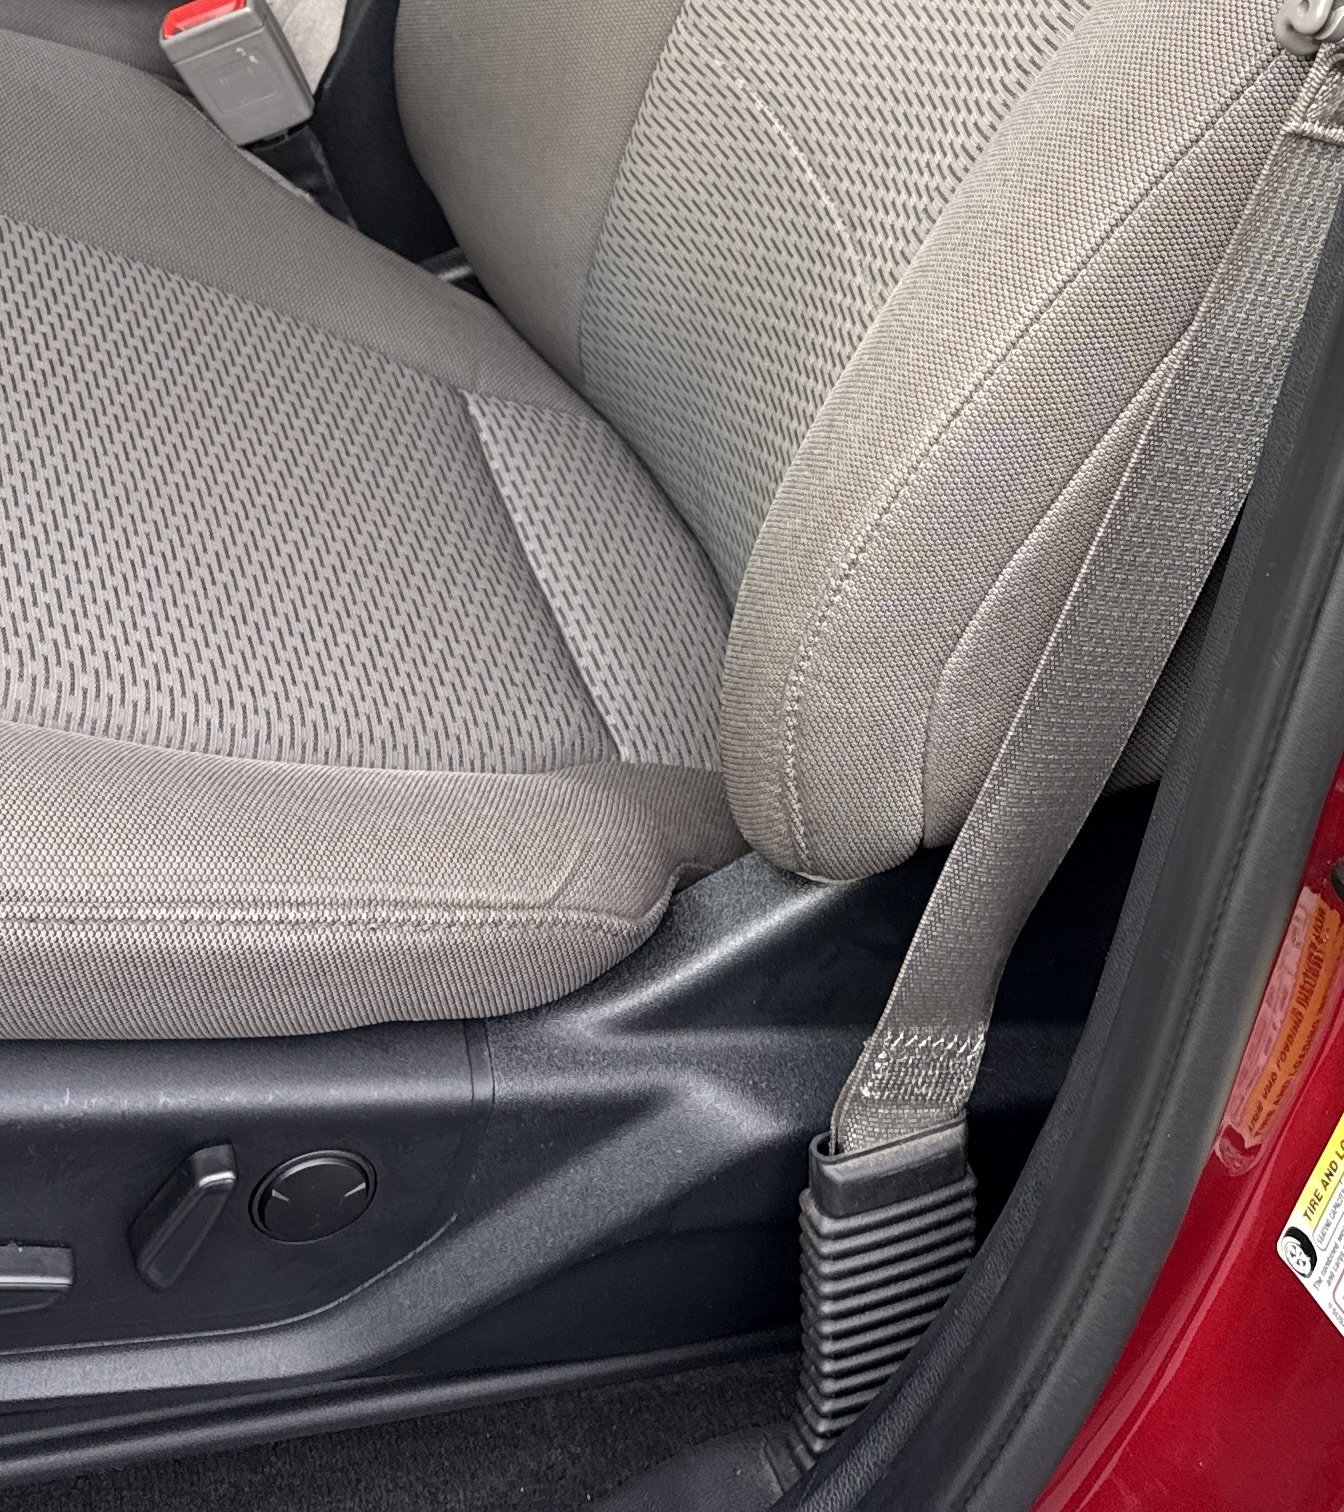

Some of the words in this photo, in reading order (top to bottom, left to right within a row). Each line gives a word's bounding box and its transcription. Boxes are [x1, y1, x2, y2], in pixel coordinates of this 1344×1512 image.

[1302, 1186, 1323, 1224] TIRE
[1319, 1156, 1339, 1192] AND
[1312, 1273, 1323, 1291] The
[1319, 1240, 1339, 1278] combined
[1325, 1270, 1335, 1287] and
[1332, 1250, 1344, 1274] cargo
